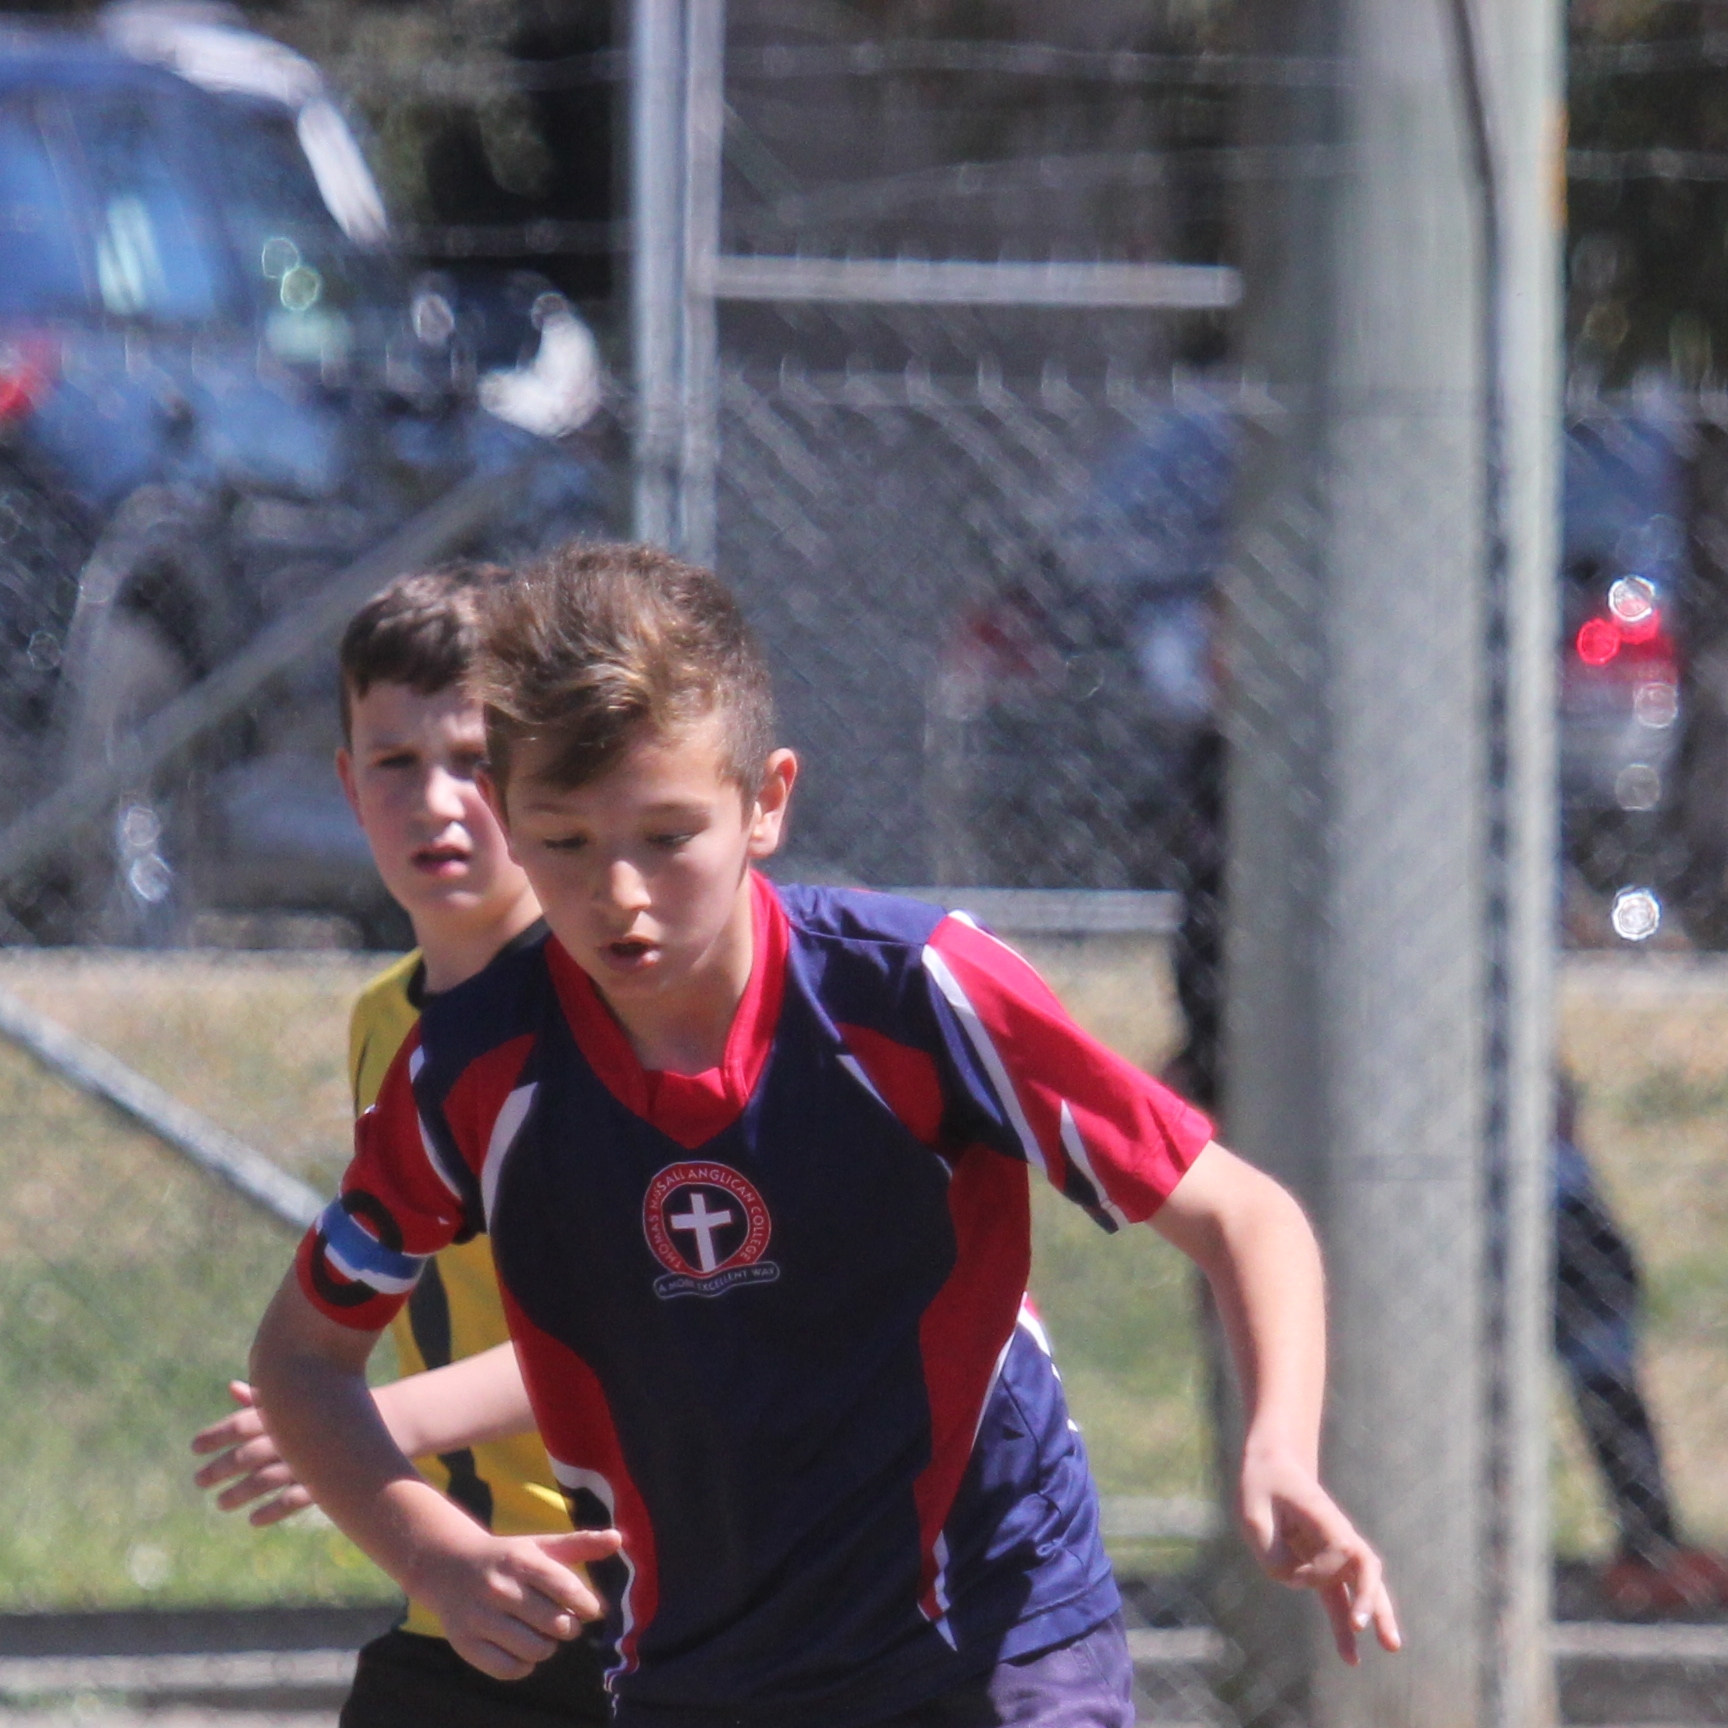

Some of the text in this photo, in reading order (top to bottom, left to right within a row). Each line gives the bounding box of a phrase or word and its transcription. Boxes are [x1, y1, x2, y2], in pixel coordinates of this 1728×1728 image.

[648, 1214, 681, 1269] THOMAS
[687, 1168, 756, 1203] ANGLICAN
[740, 1206, 764, 1261] COLLEGE
[751, 1267, 776, 1277] WAY
